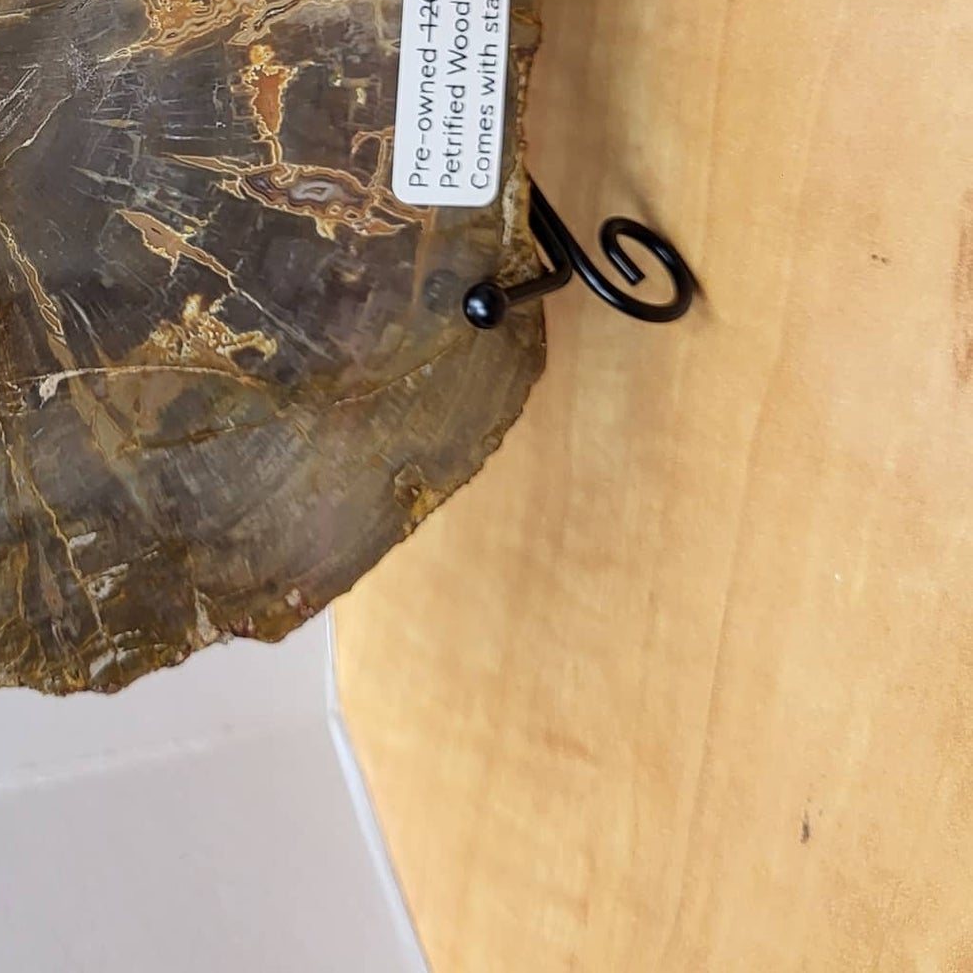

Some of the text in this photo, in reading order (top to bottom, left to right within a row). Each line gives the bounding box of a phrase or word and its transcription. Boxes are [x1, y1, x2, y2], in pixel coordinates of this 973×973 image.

[409, 48, 437, 188] Pre-owned
[439, 0, 471, 190] Petrified Wood
[477, 42, 498, 93] with
[471, 104, 496, 190] Comes
